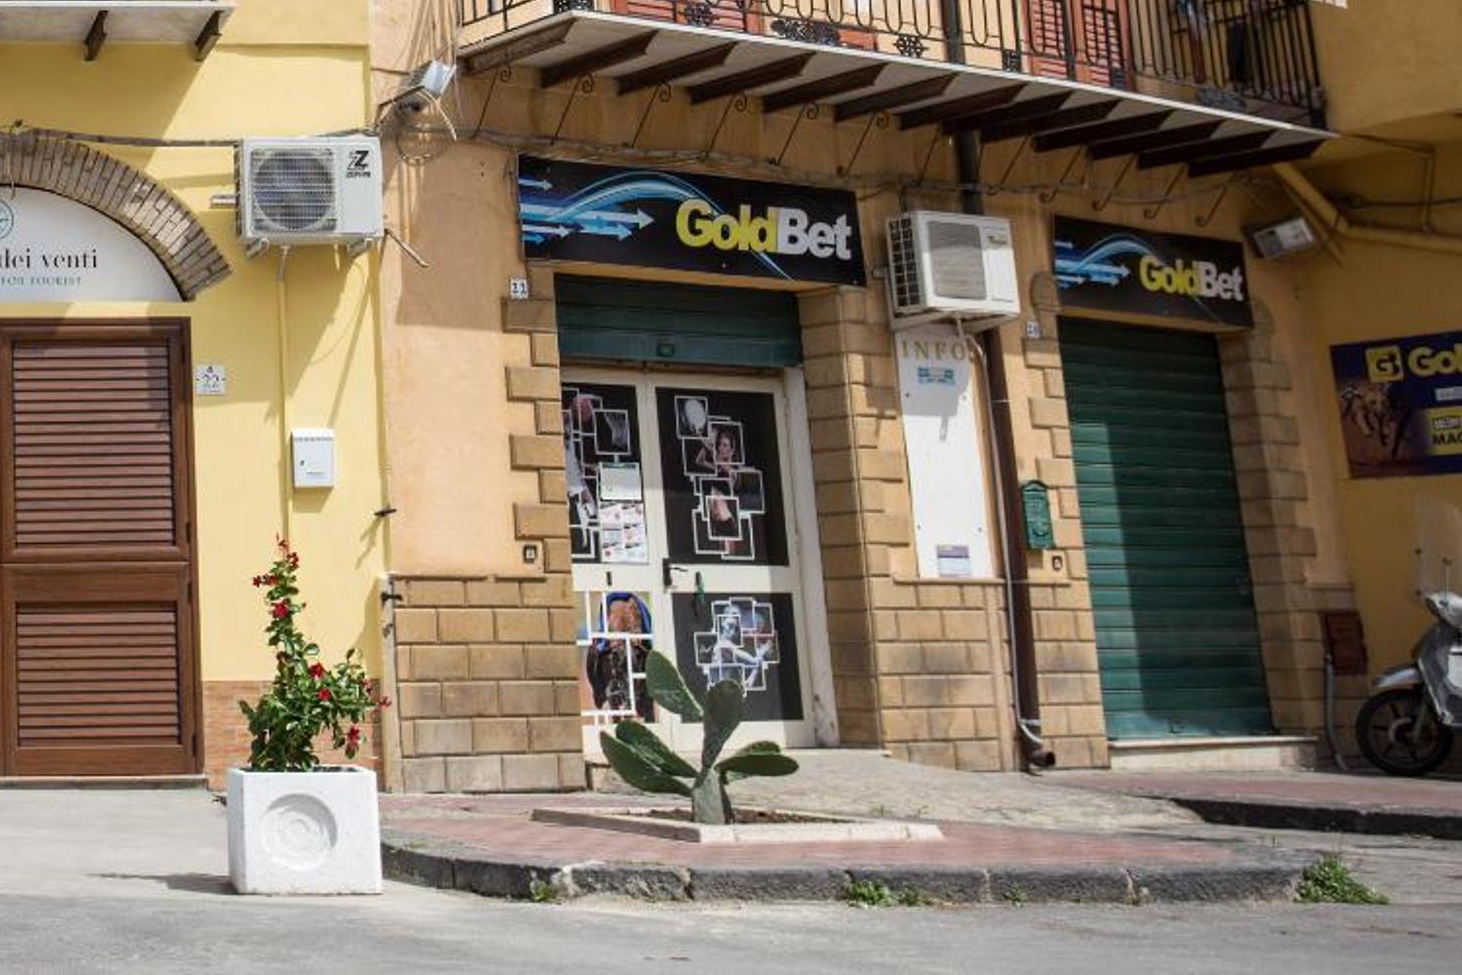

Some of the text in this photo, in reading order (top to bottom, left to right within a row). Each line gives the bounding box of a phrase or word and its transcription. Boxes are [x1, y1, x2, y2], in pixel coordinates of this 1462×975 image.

[676, 199, 852, 260] GoldBet
[41, 248, 98, 269] venti
[1139, 254, 1244, 301] GoldBet
